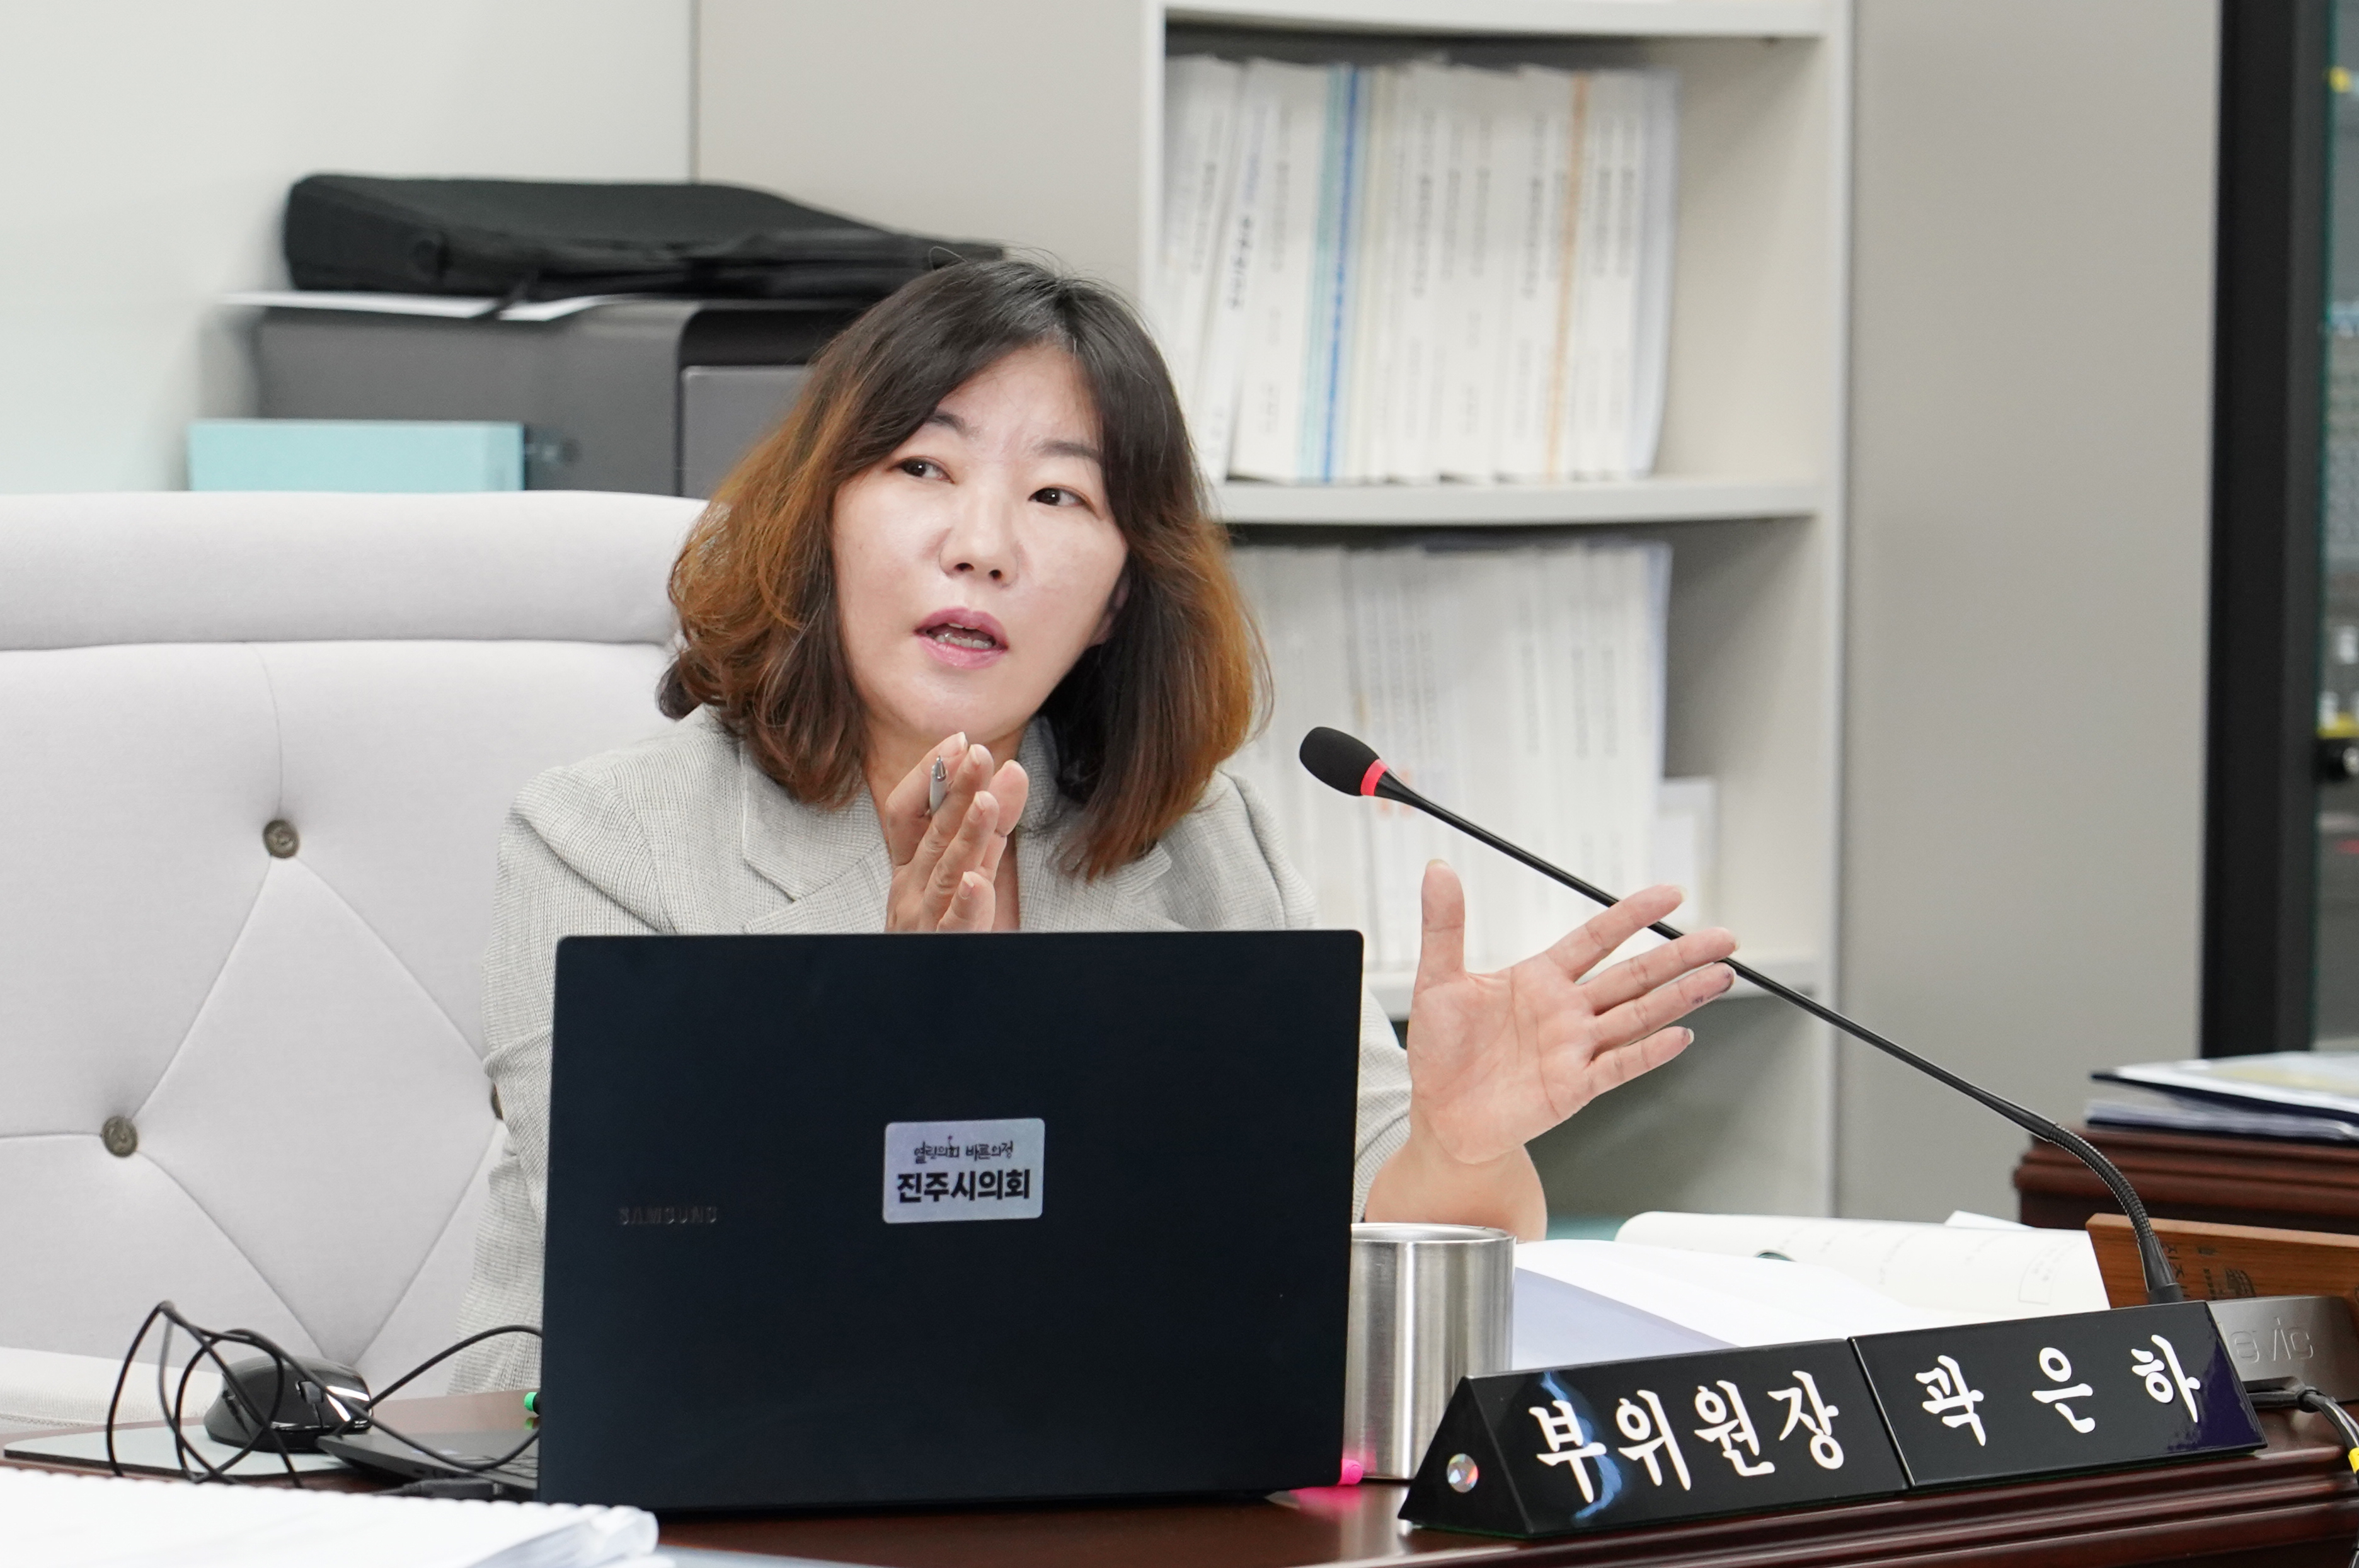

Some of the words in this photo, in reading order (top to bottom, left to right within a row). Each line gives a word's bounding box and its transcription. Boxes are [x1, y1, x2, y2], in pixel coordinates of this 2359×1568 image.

[897, 1169, 1031, 1203] 진주시의회
[618, 1206, 717, 1225] SAMSUNG
[1529, 1370, 1844, 1502] 부위원장
